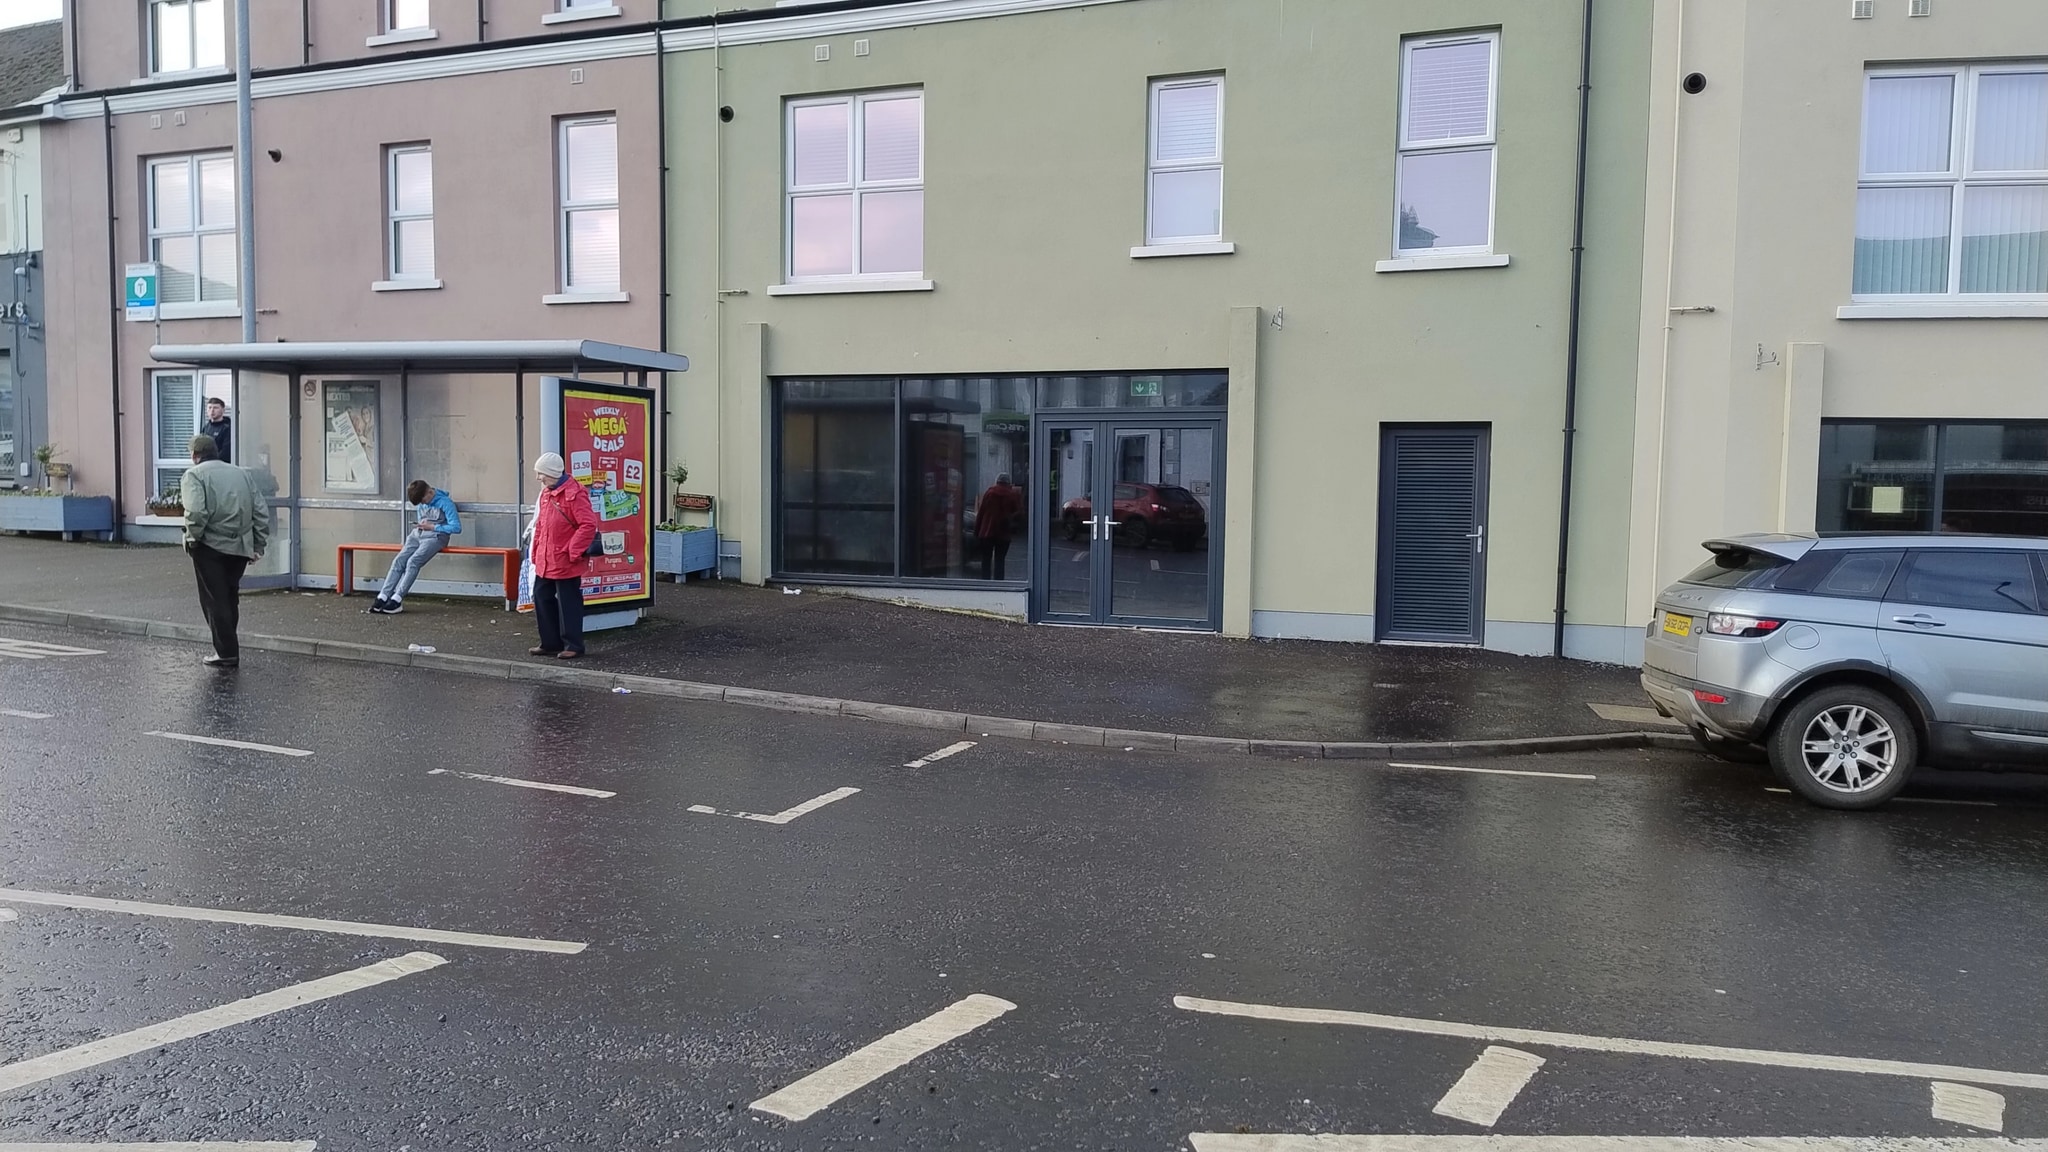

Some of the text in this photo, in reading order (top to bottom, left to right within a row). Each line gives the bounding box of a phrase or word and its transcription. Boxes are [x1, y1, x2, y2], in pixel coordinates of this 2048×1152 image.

[593, 406, 620, 417] WEEKLY
[588, 417, 628, 436] MEGA
[593, 435, 625, 452] DEALS
[573, 461, 590, 470] £3.50
[625, 464, 641, 480] £2
[610, 490, 628, 505] BIG
